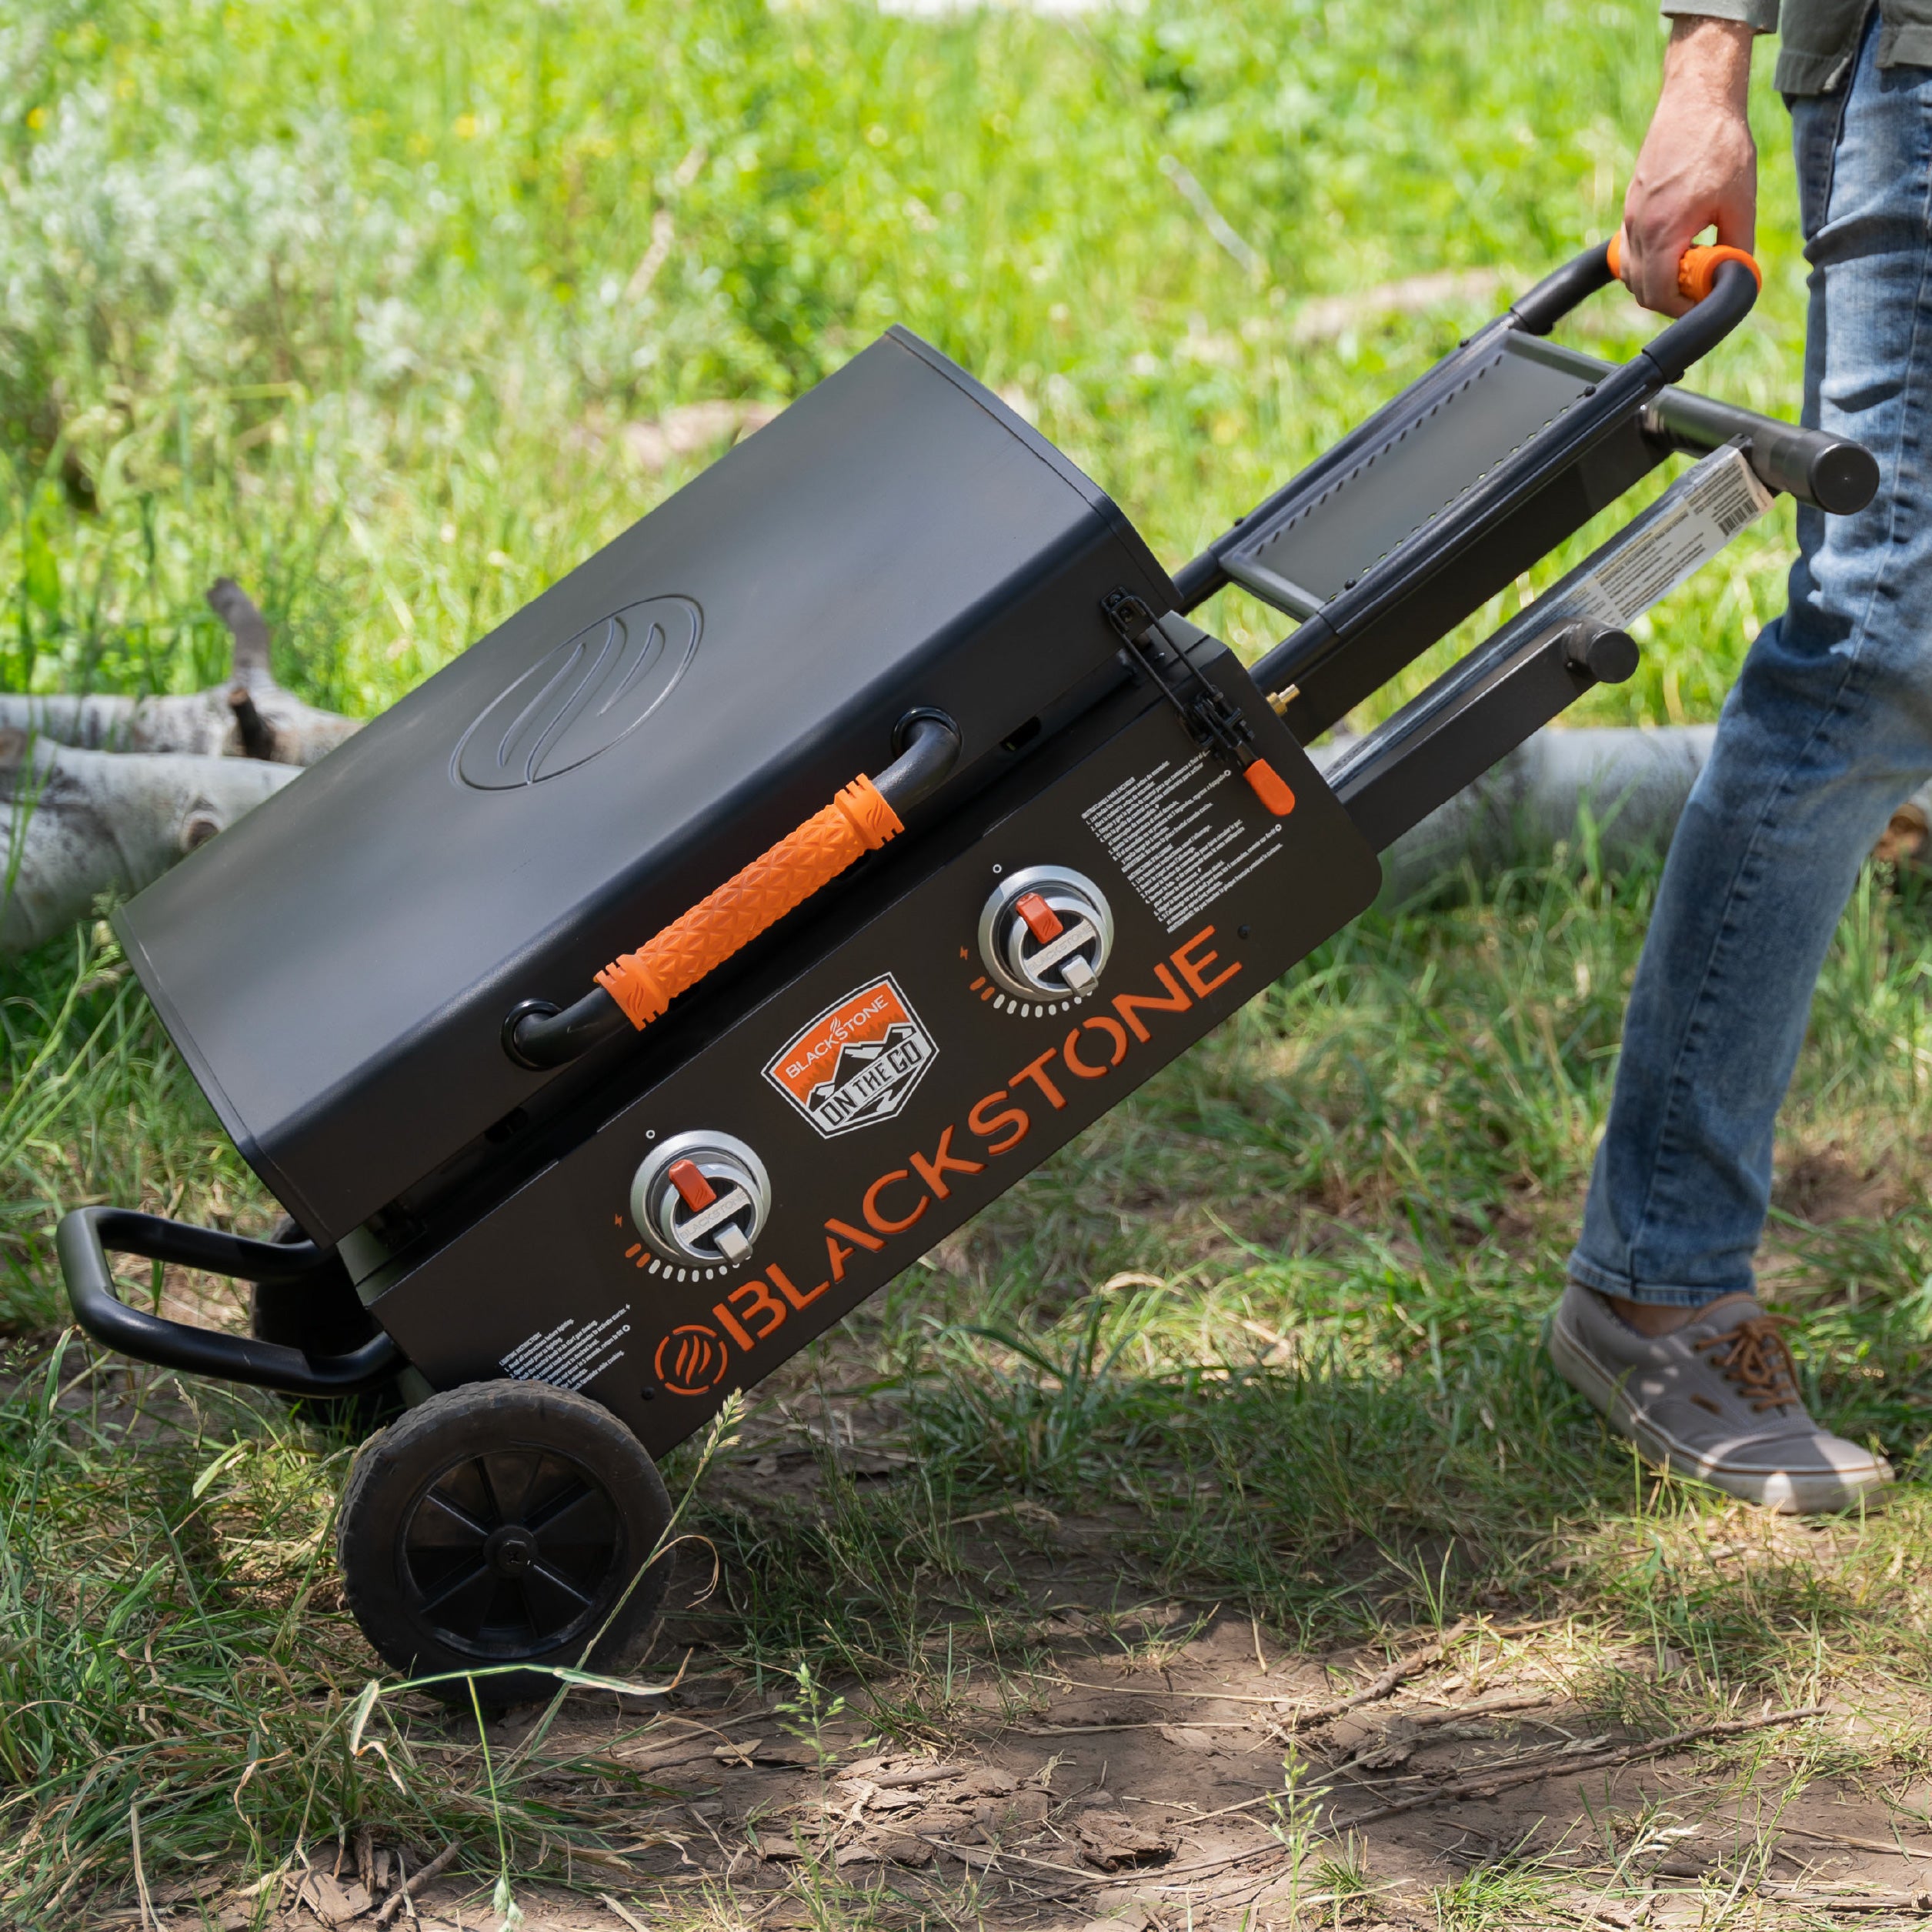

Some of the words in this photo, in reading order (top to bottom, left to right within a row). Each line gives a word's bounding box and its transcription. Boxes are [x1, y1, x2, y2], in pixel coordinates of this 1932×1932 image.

[786, 995, 889, 1079] BLACKSTONE
[819, 1087, 858, 1126] ON
[852, 1062, 893, 1098] THE
[887, 1041, 922, 1073] GO
[712, 926, 1243, 1351] BLACKSTONE
[680, 1191, 746, 1240] BLACKSTONE
